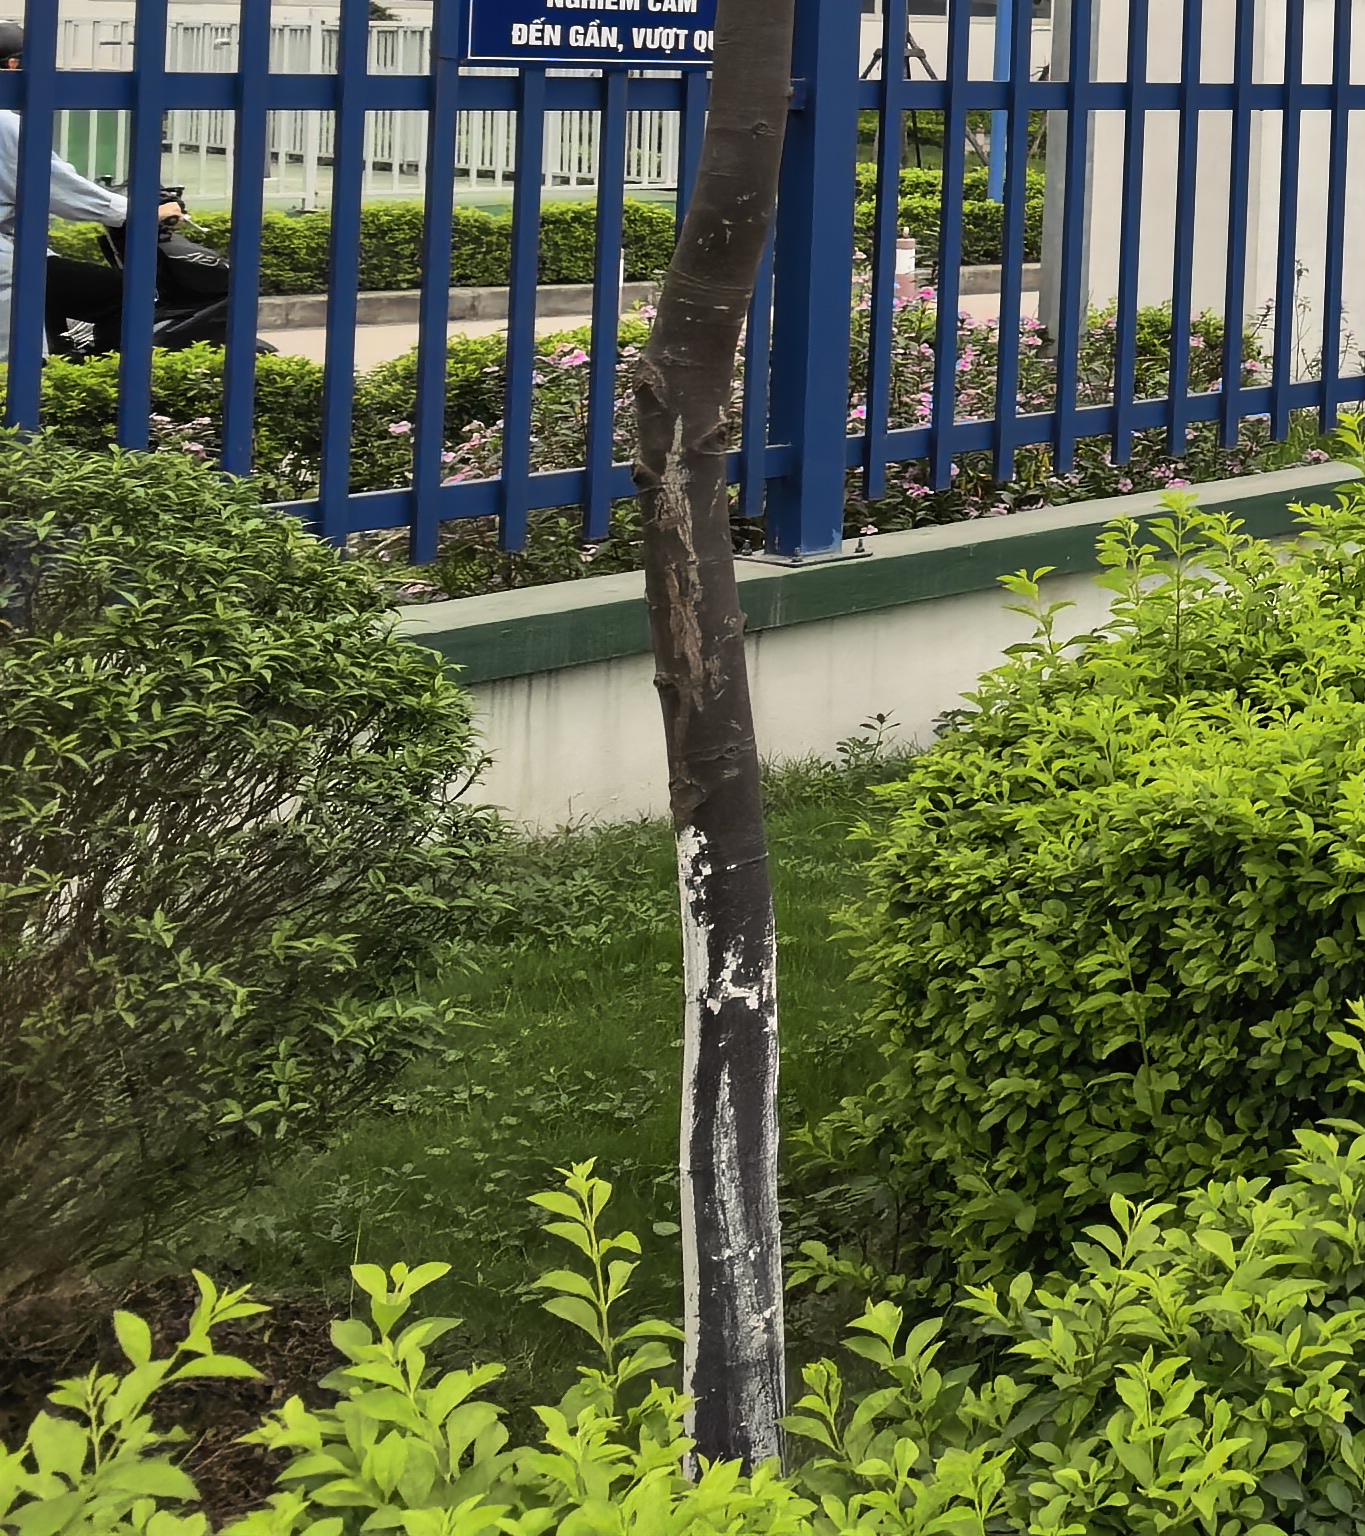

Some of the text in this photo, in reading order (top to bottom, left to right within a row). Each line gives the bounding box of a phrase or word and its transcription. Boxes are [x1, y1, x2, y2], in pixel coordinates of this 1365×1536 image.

[511, 17, 562, 46] ĐẾN
[568, 18, 624, 53] GẦN,
[632, 26, 689, 54] VƯỢT
